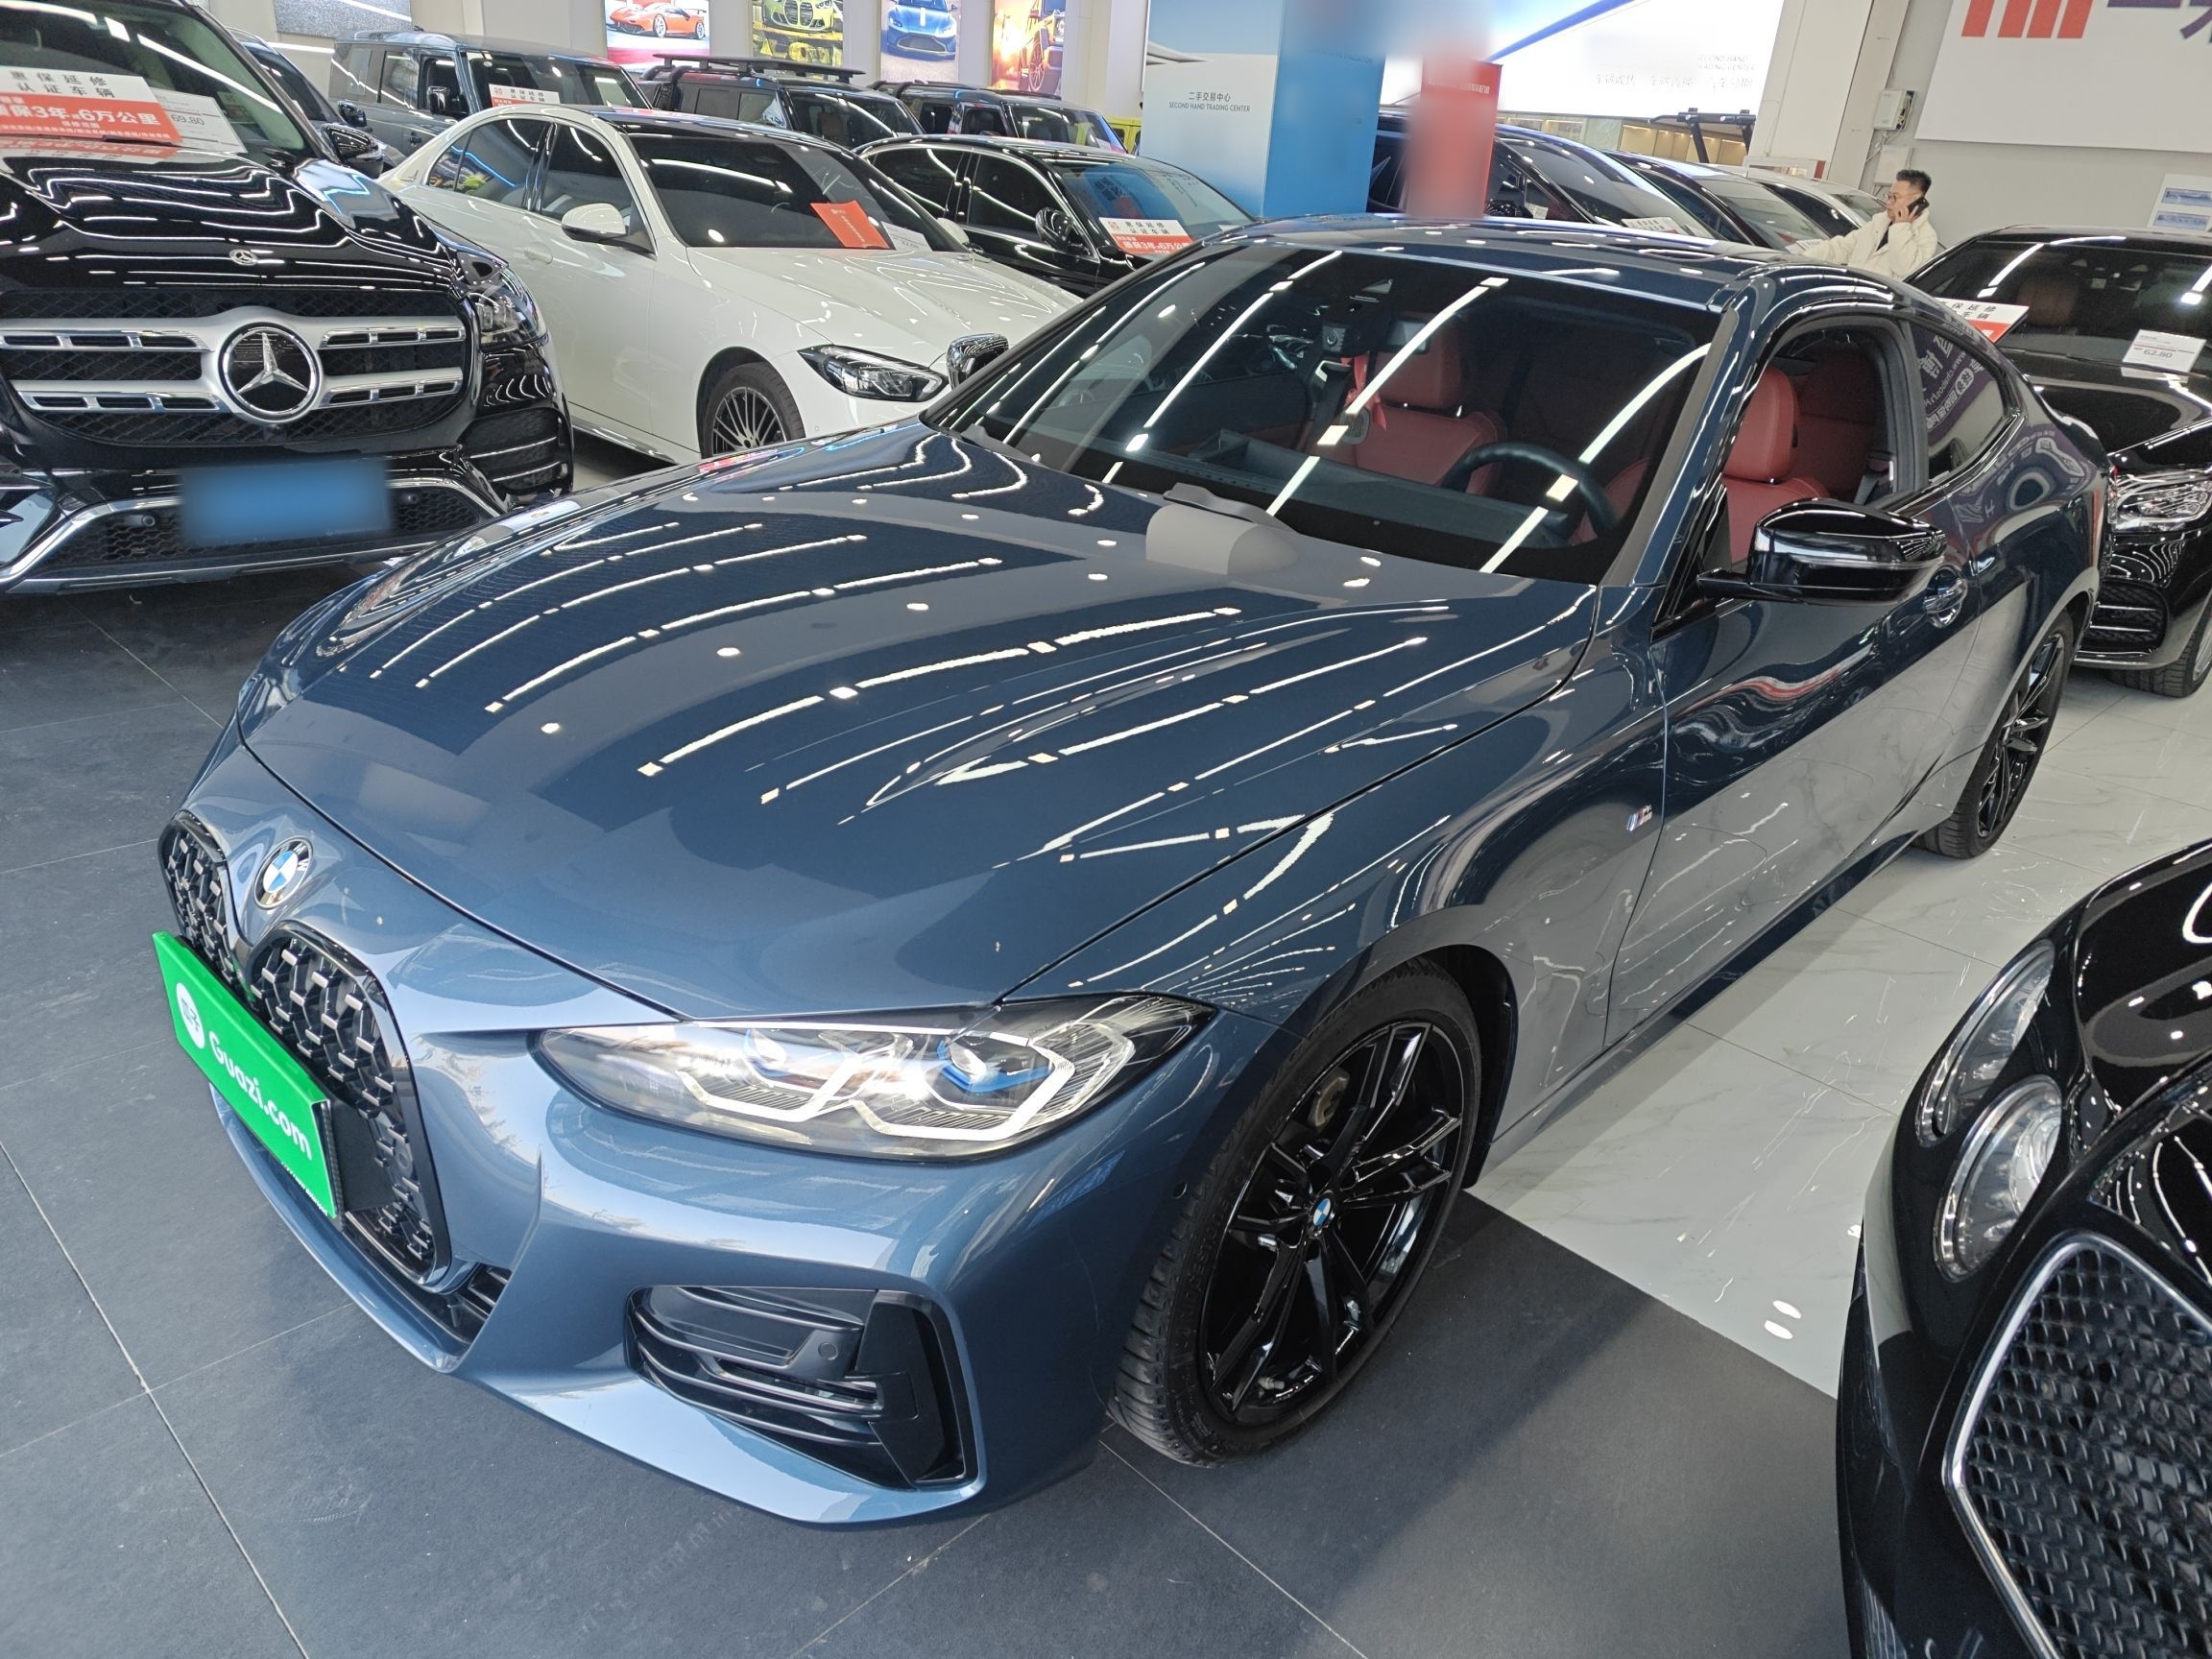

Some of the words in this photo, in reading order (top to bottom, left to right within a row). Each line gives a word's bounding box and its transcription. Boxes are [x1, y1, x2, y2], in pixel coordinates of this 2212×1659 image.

[1188, 91, 1231, 103] 二手交易中心
[1168, 101, 1190, 109] SECOND
[1206, 103, 1229, 111] TRADING
[1230, 104, 1251, 112] CENTER
[2143, 349, 2174, 359] 62.80
[208, 1030, 313, 1161] Guazi.com
